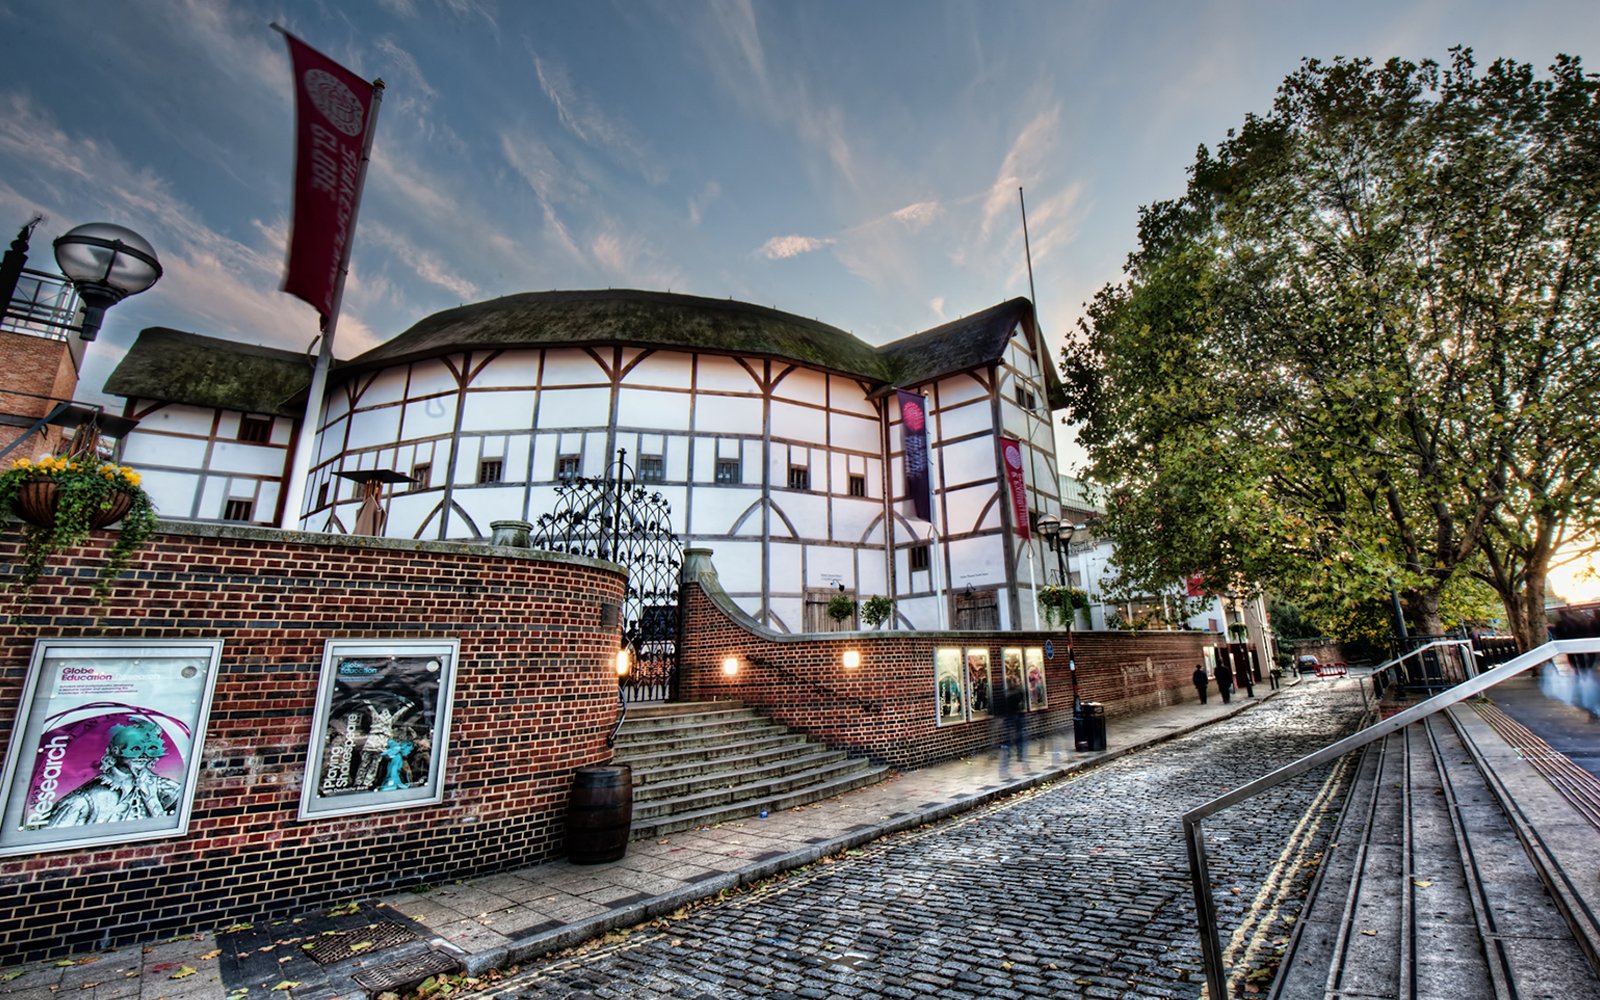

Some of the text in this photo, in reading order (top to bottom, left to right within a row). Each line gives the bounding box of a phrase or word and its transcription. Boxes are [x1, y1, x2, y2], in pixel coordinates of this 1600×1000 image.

[309, 122, 339, 201] GLOBE
[62, 667, 94, 675] Globe
[26, 735, 69, 826] Research
[323, 746, 344, 788] Playing
[335, 713, 358, 788] Shakespeare
